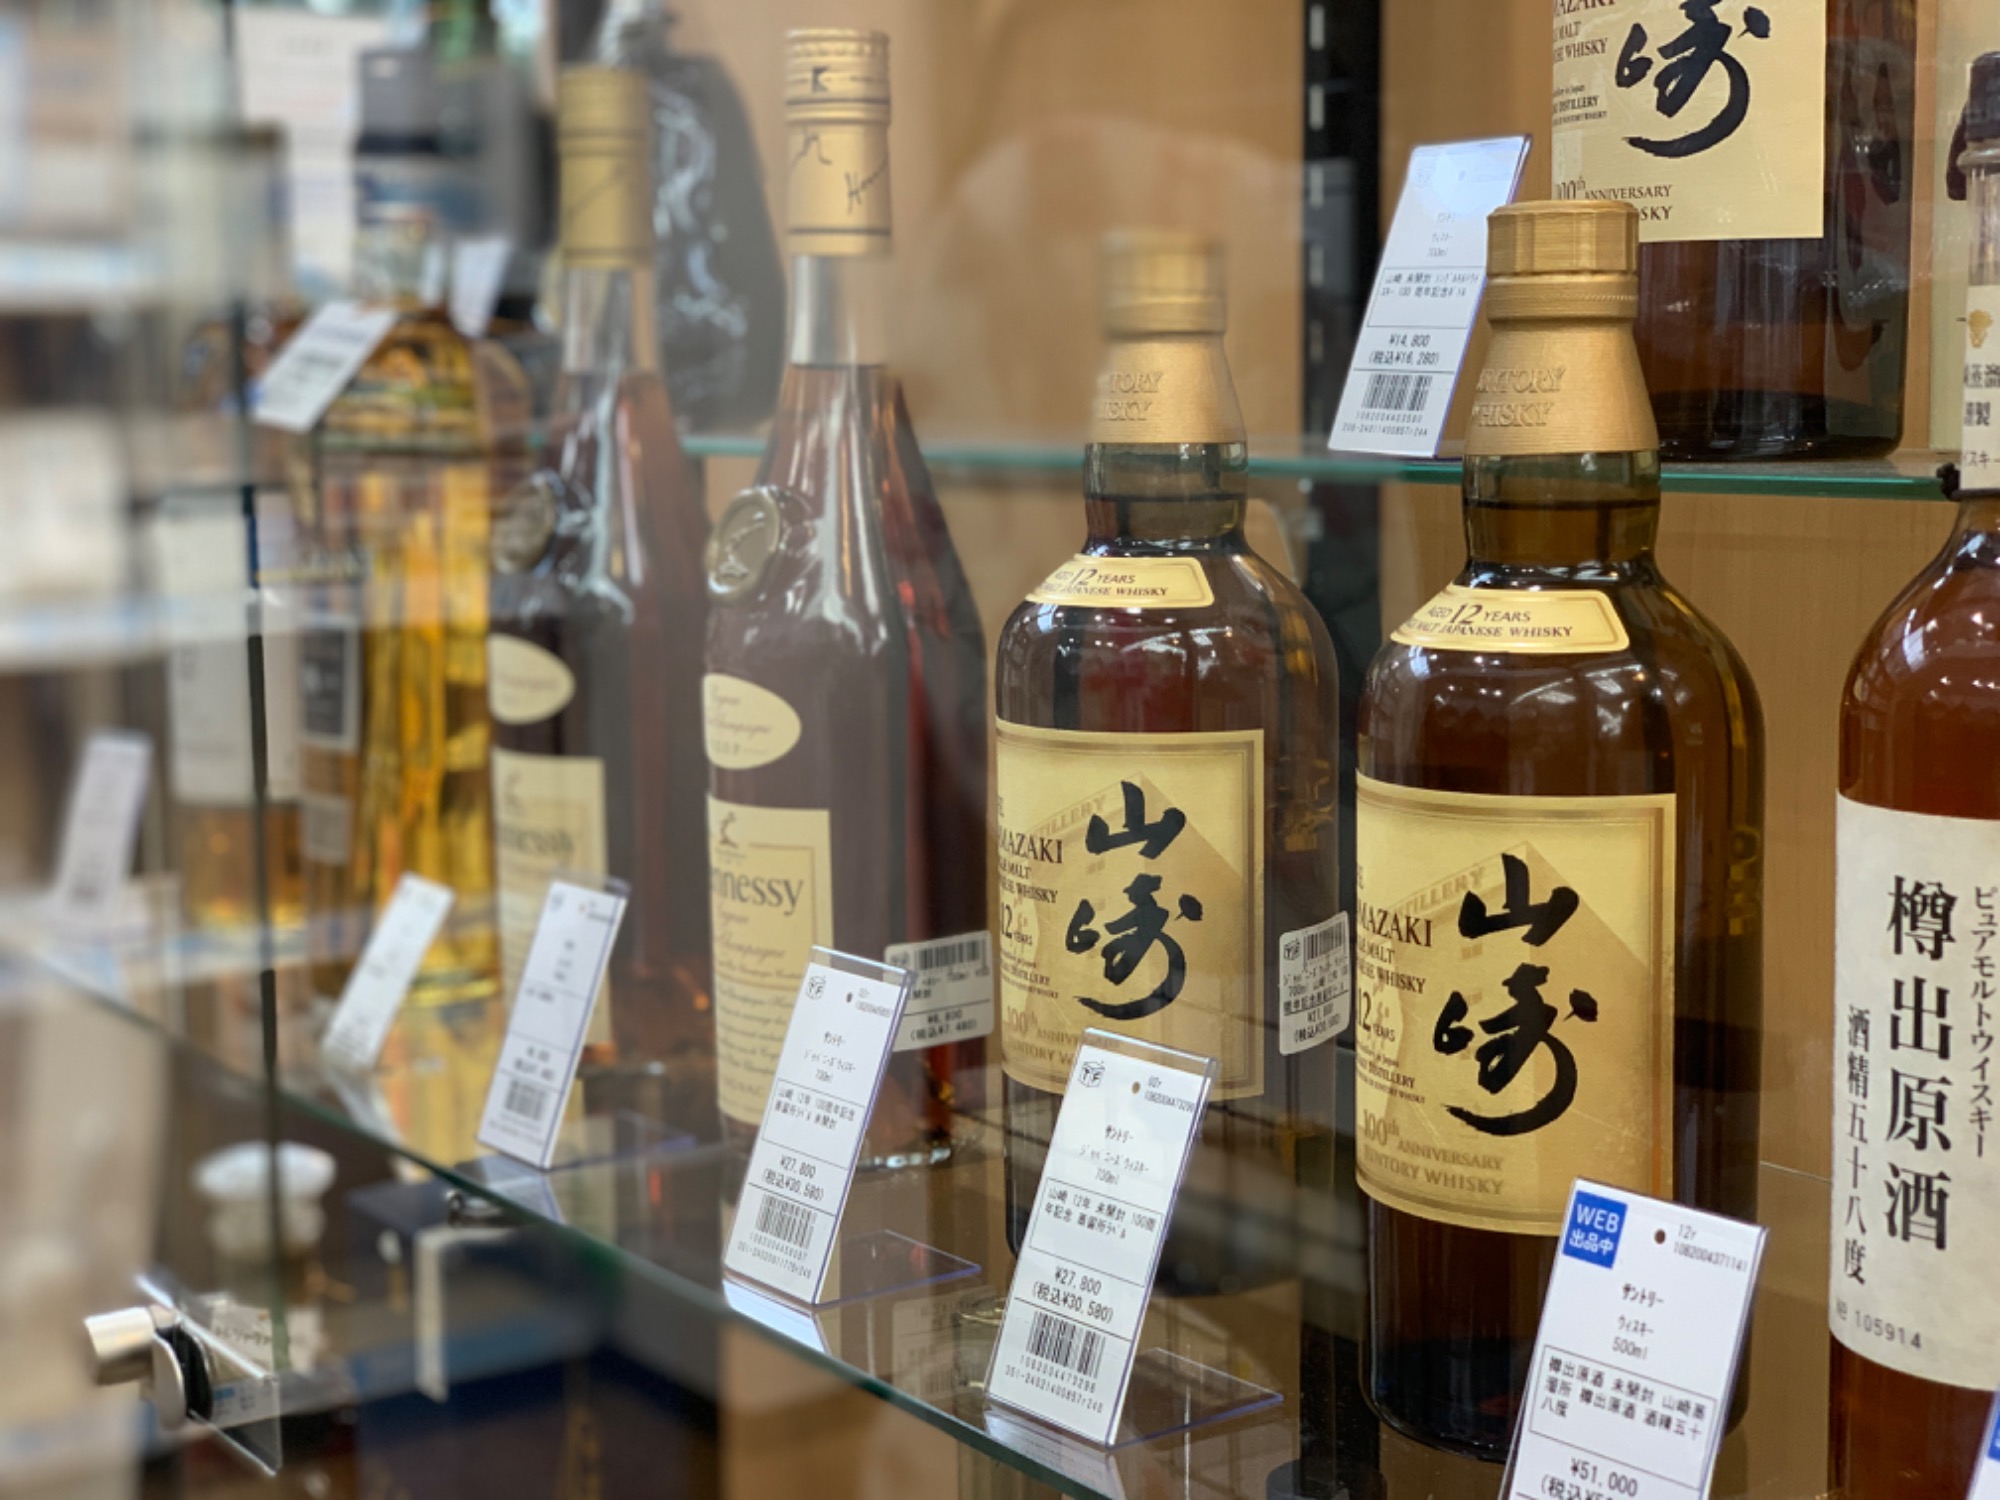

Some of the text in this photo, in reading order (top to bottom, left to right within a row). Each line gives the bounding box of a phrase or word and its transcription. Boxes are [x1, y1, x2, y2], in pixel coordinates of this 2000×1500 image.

[1565, 37, 1608, 58] WHISKY
[1585, 184, 1673, 199] ANNIVERSARY
[1640, 205, 1673, 221] SKY
[1070, 569, 1097, 585] 12
[1097, 574, 1135, 584] YEARS
[1116, 587, 1168, 596] WHISKY
[1450, 603, 1483, 625] 12
[1484, 610, 1531, 622] YEARS
[1439, 623, 1503, 637] JAPANESE
[1509, 626, 1573, 637] WHISKY
[1016, 882, 1058, 904] WHISKY
[1367, 940, 1396, 964] MALT
[1376, 966, 1426, 994] WHISKY
[1358, 987, 1371, 1032] 12
[1968, 886, 1998, 1158] ピュアモルトウイスキー
[1884, 875, 1958, 1251] 樽出原酒
[1363, 1109, 1504, 1171] 100th ANNIVERSARY
[1844, 1004, 1870, 1285] 酒精五十八度
[1095, 1168, 1120, 1185] 700ml
[1364, 1144, 1504, 1194] SUNTORY WHISKY
[1576, 1204, 1620, 1233] WEB
[1569, 1228, 1613, 1256] 出品中
[1855, 1309, 1921, 1349] 105914
[1612, 1337, 1648, 1360] 500ml
[1549, 1356, 1604, 1387] 樽出原酒
[1611, 1377, 1654, 1402] 未開封
[1541, 1396, 1568, 1418] 八度
[1580, 1386, 1636, 1420] 樽出原酒
